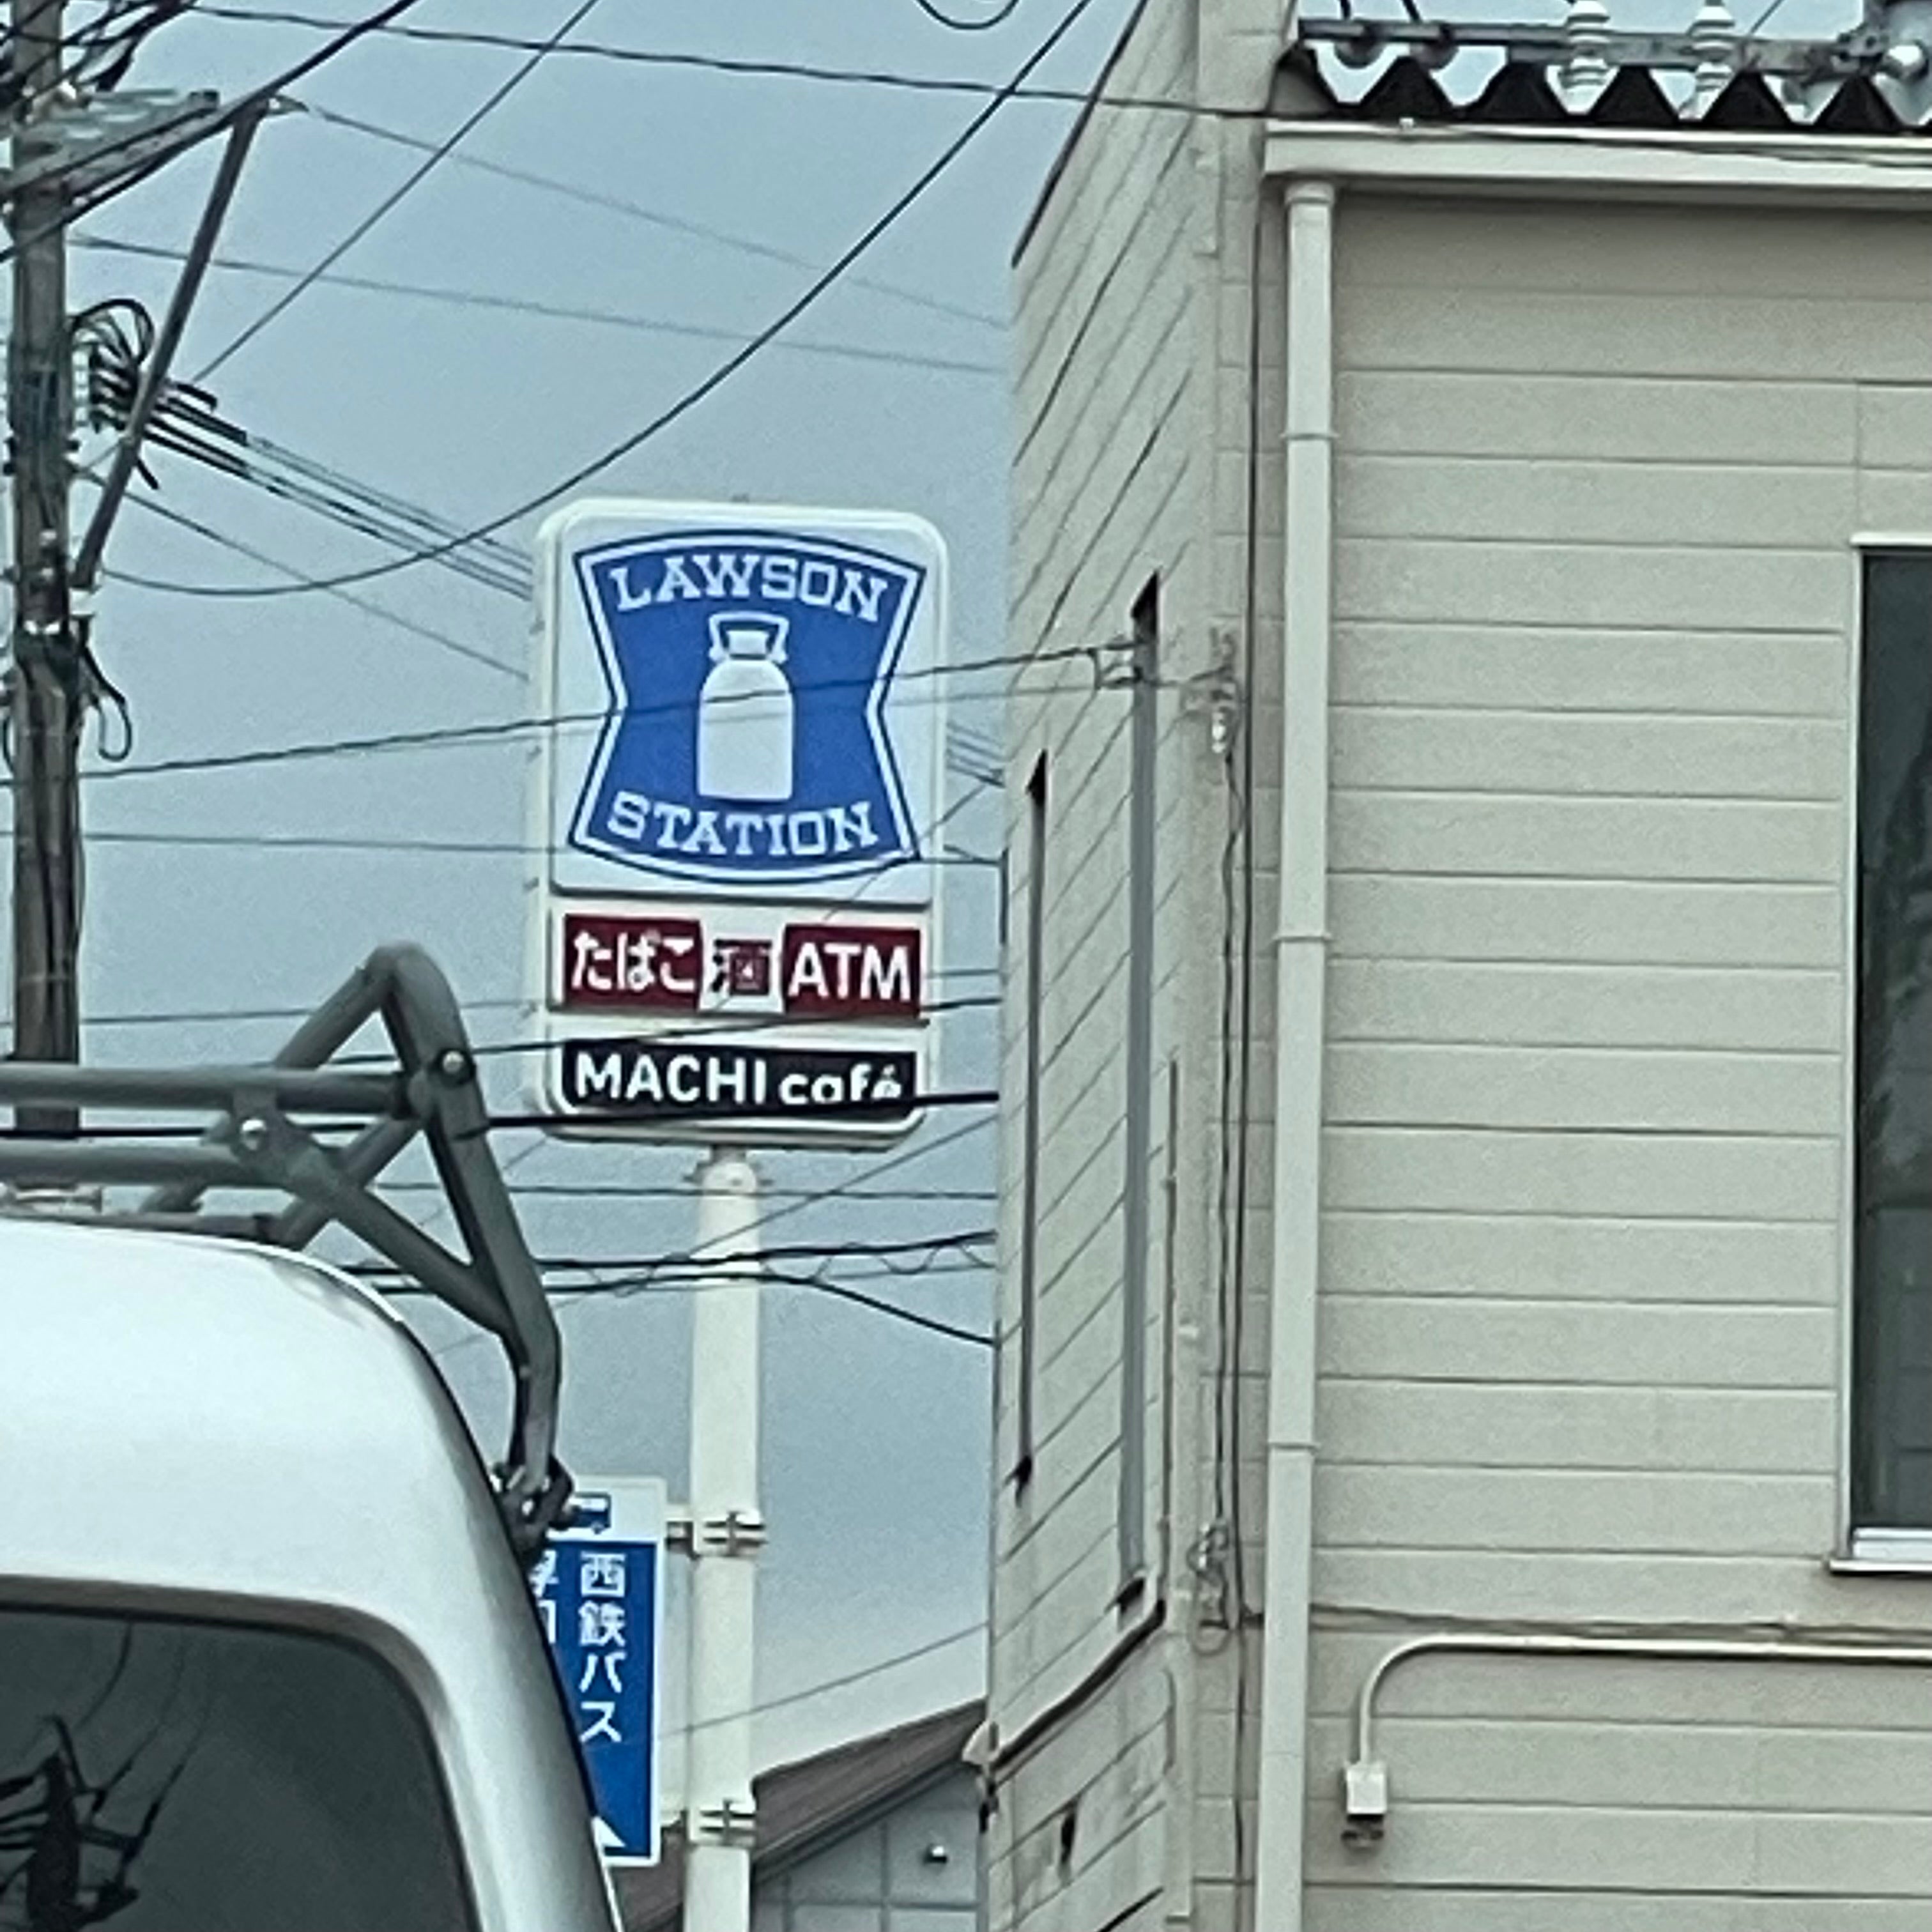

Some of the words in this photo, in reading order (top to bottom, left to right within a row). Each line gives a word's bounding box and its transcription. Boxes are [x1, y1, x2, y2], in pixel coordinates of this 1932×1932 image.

[610, 555, 887, 621] LAWSON
[608, 791, 878, 855] STATION
[573, 931, 696, 991] たばこ
[787, 942, 912, 1002] ATM
[577, 1054, 765, 1105] MACHI
[779, 1064, 902, 1105] café
[578, 1551, 626, 1743] 西鉄バス
